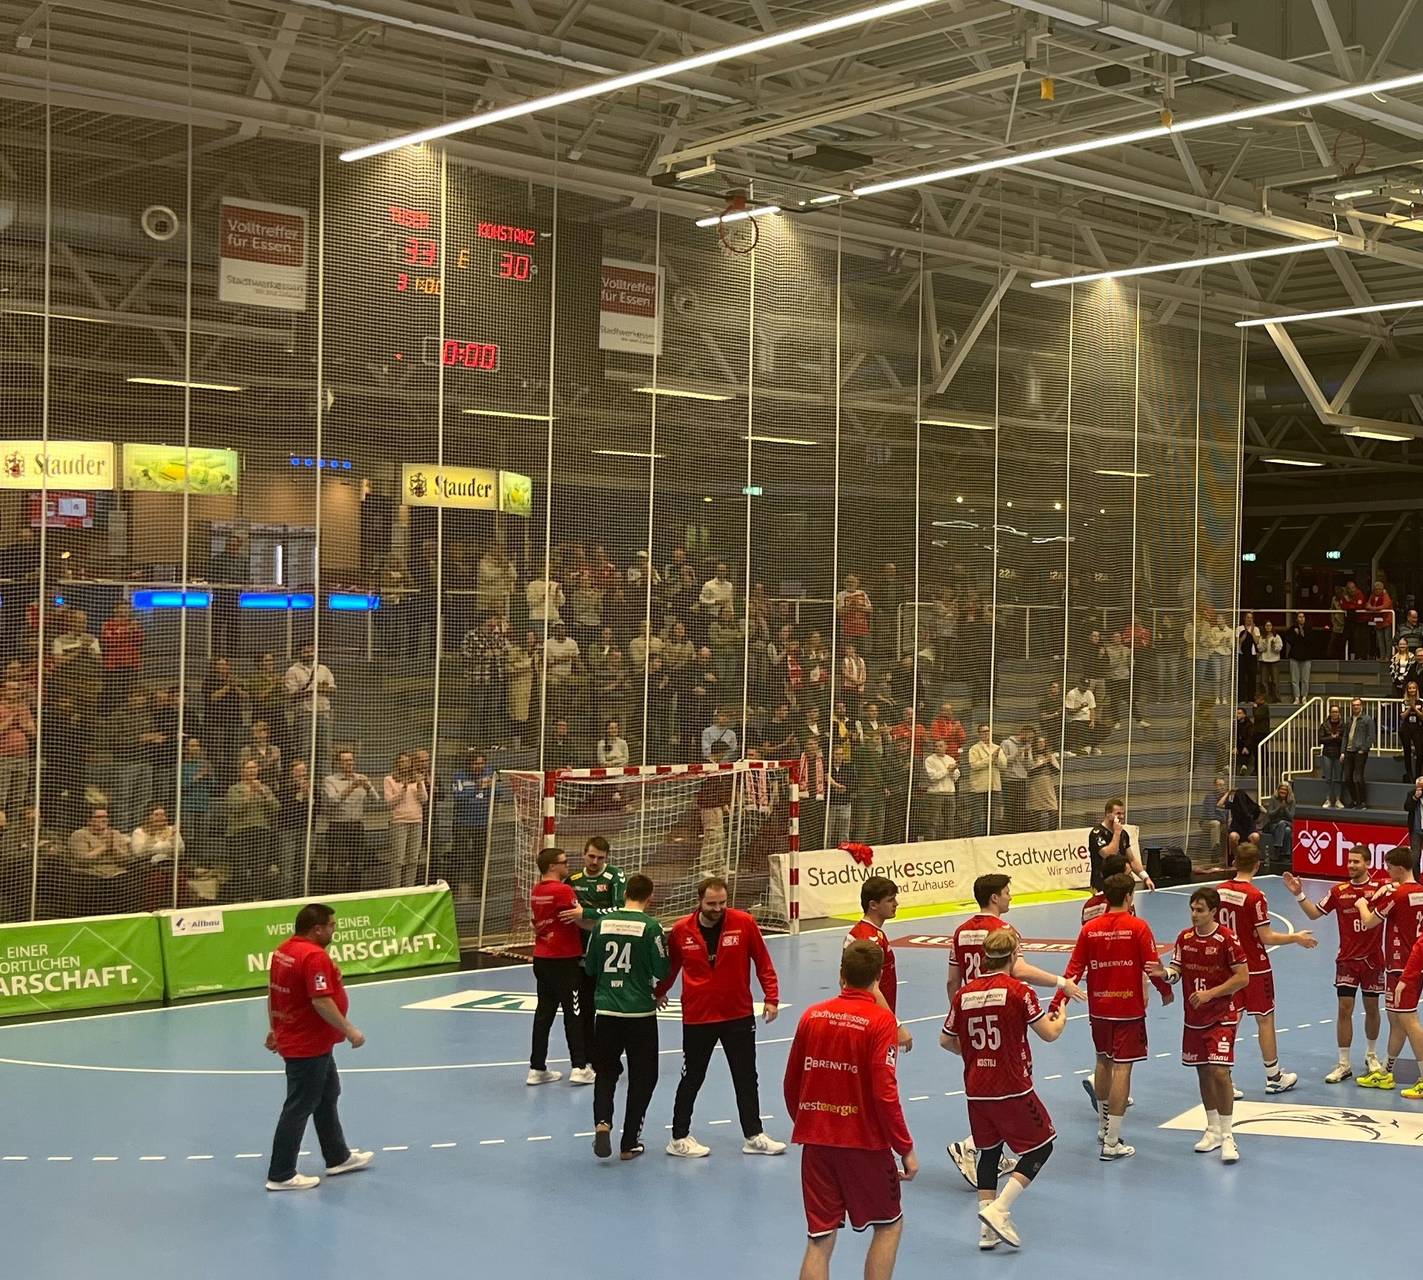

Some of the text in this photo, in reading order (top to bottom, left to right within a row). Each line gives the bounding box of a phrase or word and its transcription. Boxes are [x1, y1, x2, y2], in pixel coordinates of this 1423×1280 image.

[227, 219, 299, 241] Volltreffer
[226, 233, 292, 253] für Essen
[404, 238, 437, 267] 33
[499, 251, 531, 282] 30
[601, 277, 655, 296] Volltreffer
[620, 291, 650, 308] Essen
[443, 340, 497, 370] 0:00
[34, 452, 105, 477] Stauder
[434, 474, 492, 499] Stauder
[996, 842, 1089, 868] Stadtwerke
[807, 857, 955, 888] Stadtwerkessen
[1047, 866, 1062, 877] Wir
[1064, 864, 1082, 875] sind
[338, 915, 371, 928] EINER
[1219, 907, 1237, 936] 91
[333, 926, 396, 943] ORTLICHEN
[7, 943, 48, 959] EINER
[603, 940, 632, 974] 24
[0, 955, 80, 975] ORTLICHEN
[0, 964, 138, 997] ARSCHAFT.
[1193, 977, 1207, 991] 15
[967, 1014, 1002, 1051] 55
[811, 1059, 859, 1074] BRENNTAG
